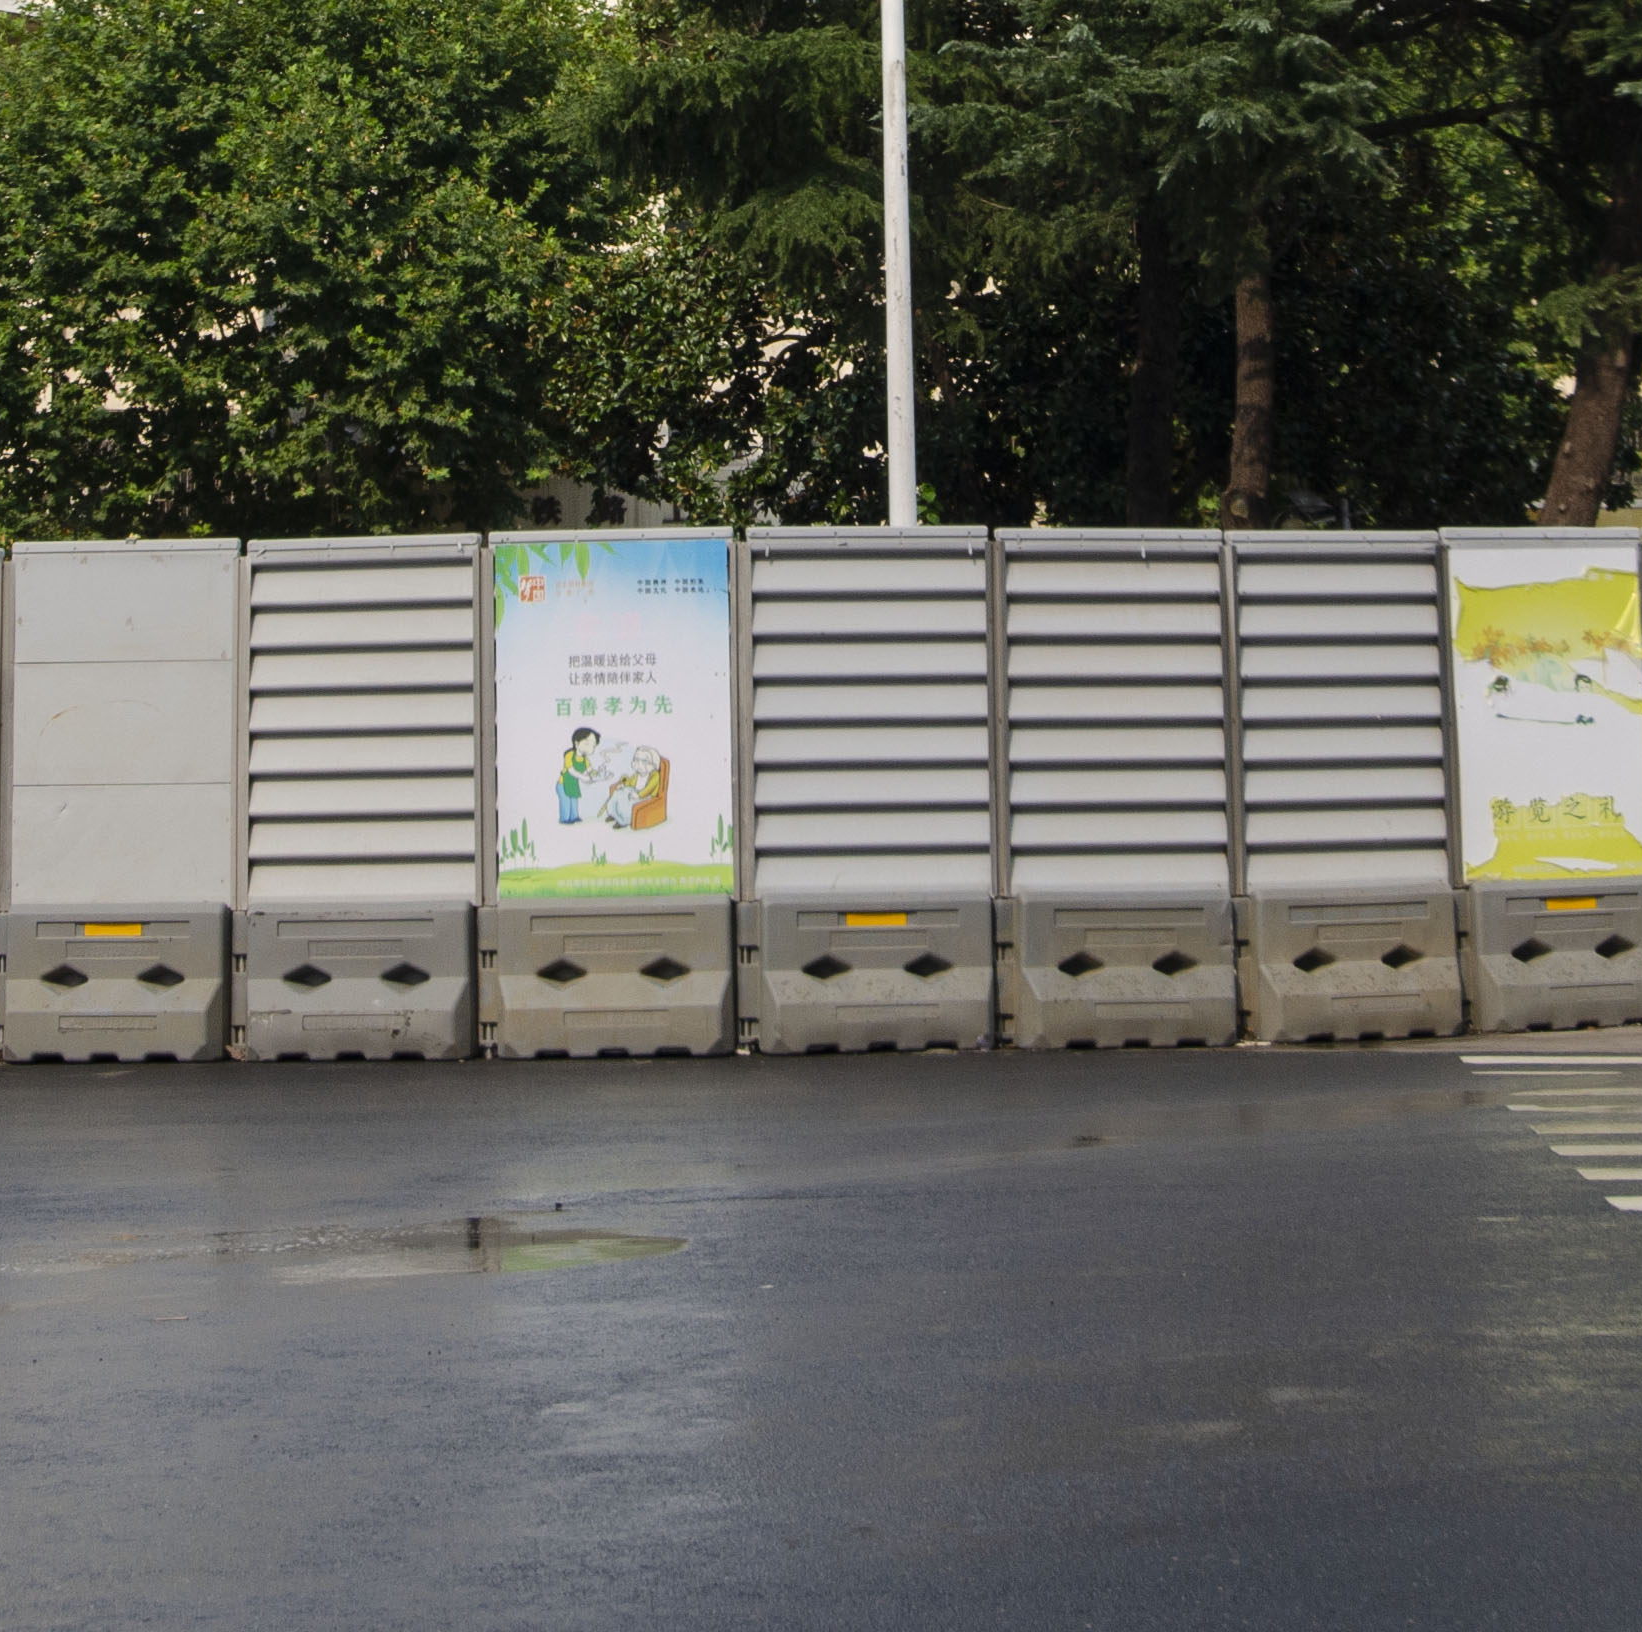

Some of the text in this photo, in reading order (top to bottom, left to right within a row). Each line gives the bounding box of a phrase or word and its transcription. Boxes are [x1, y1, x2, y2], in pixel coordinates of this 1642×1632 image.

[568, 653, 657, 668] 把温暖送给父母
[568, 670, 657, 686] 让亲情陪伴家人
[555, 694, 673, 717] 百善孝为先
